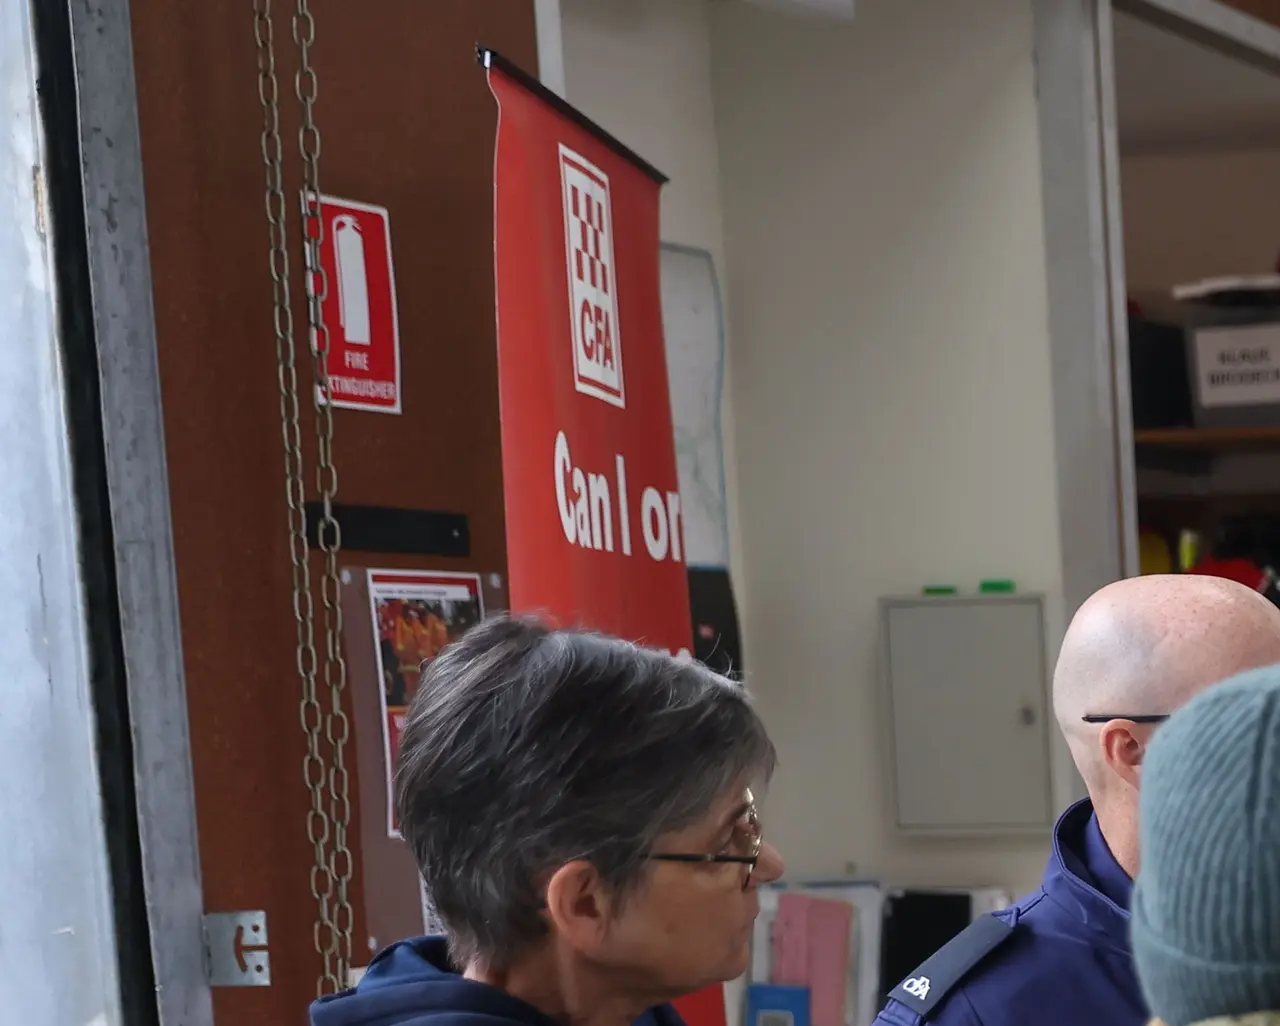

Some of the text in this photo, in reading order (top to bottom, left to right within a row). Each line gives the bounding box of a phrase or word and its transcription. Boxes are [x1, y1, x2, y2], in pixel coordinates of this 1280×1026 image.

[580, 298, 615, 372] CFA
[344, 349, 370, 371] FIRE
[322, 375, 396, 400] XTINGUISHER
[554, 429, 614, 553] Can
[615, 454, 632, 557] I
